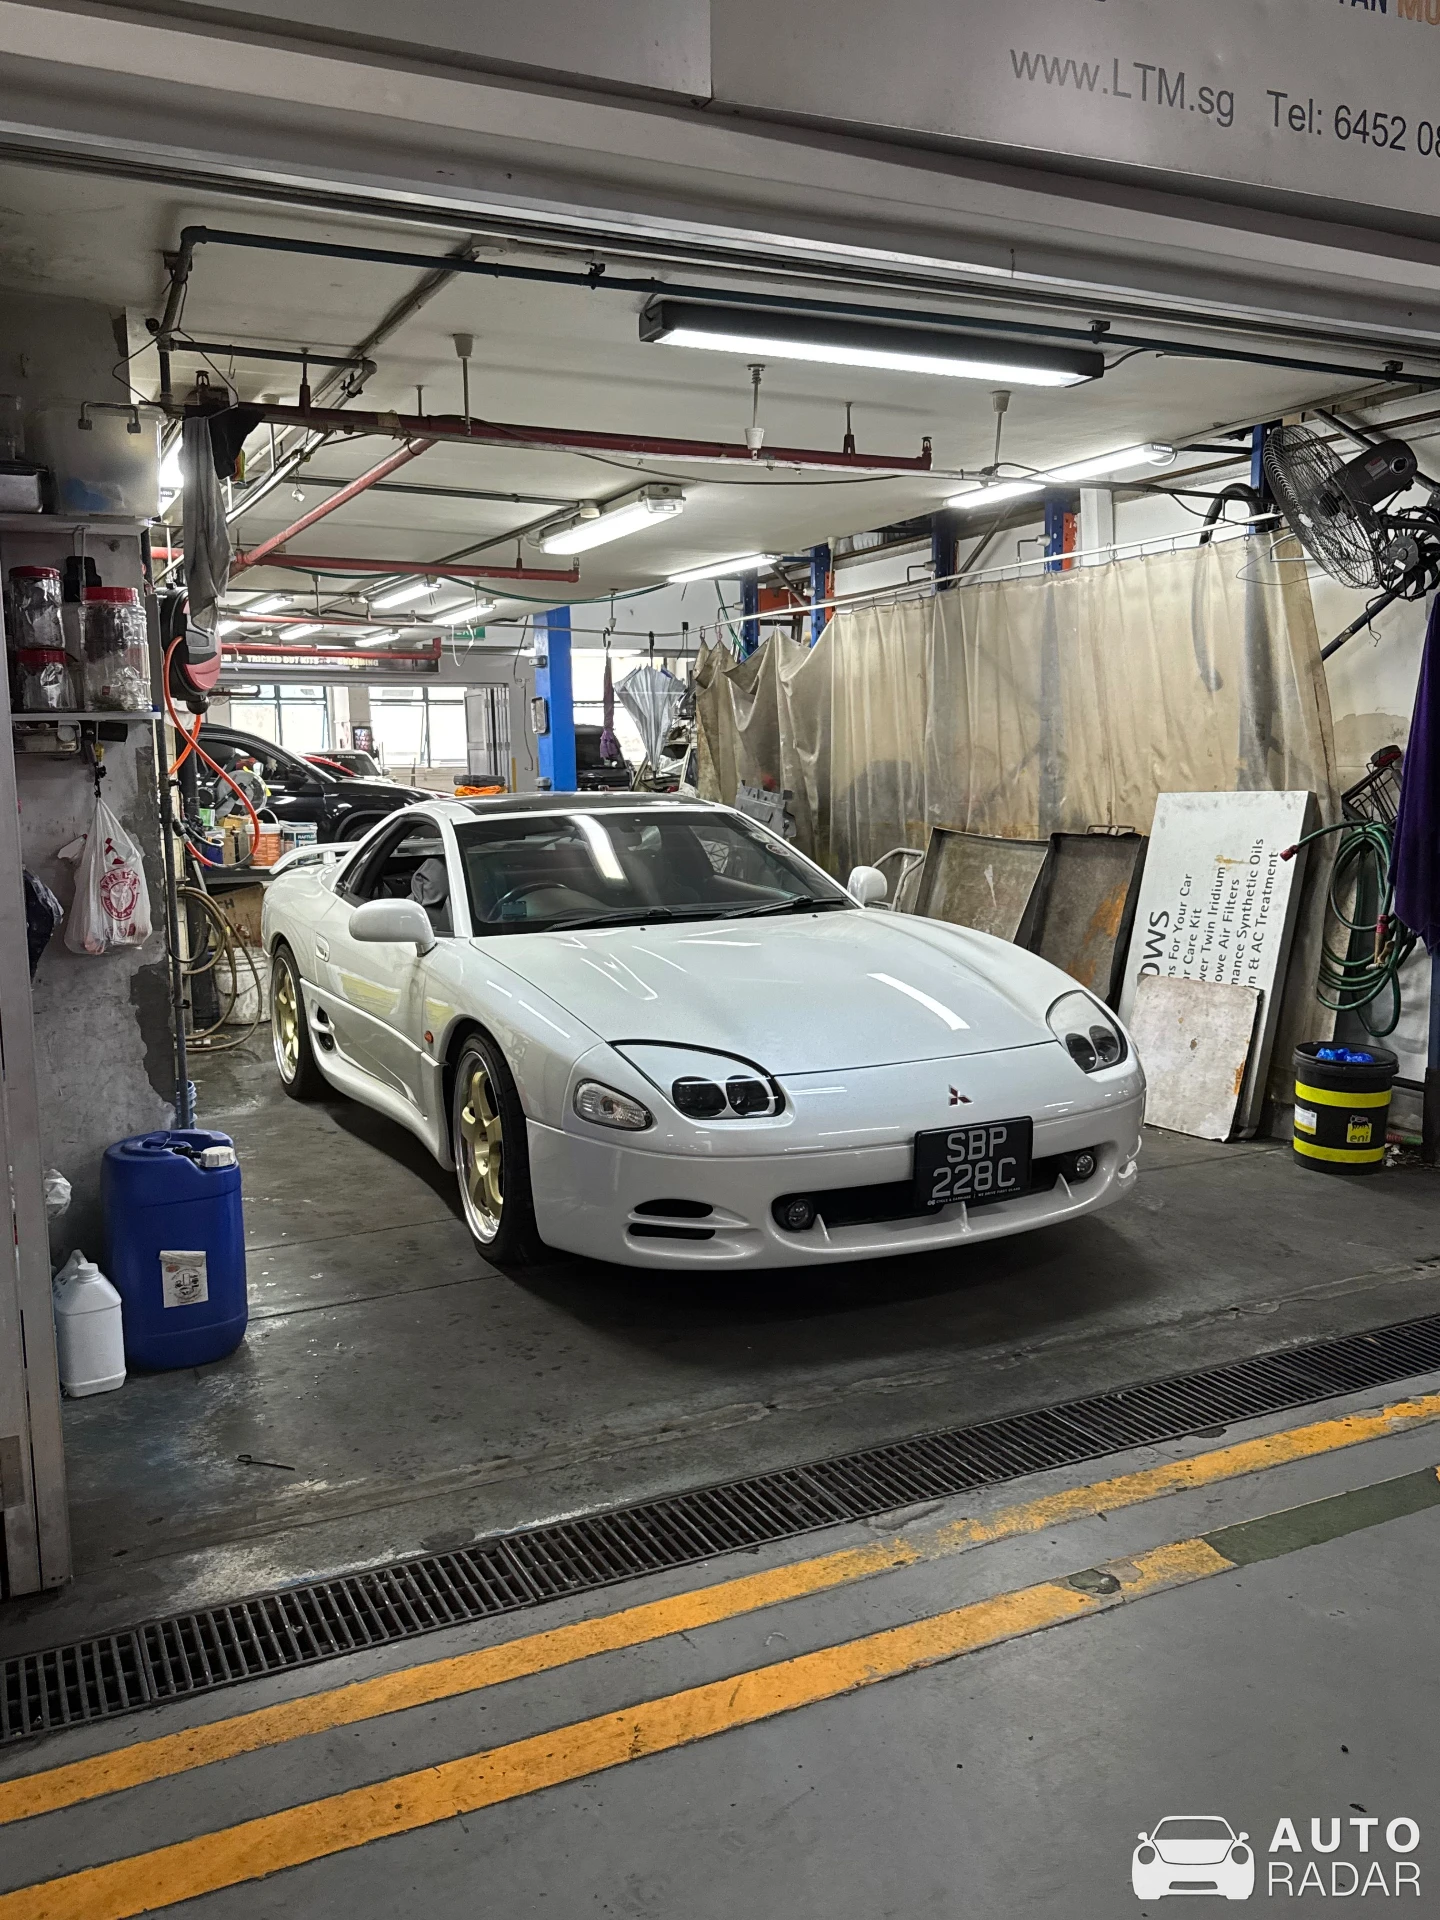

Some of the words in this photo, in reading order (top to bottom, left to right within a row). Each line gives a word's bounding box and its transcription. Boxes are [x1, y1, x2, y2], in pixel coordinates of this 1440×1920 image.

[1009, 48, 1235, 128] www.LTM.sg
[1266, 90, 1323, 136] Tel:
[1334, 105, 1407, 152] 6452
[1180, 873, 1193, 897] Car
[1207, 867, 1226, 915] Iridium
[1223, 879, 1240, 923] Filters
[1237, 870, 1258, 938] Synthetic
[1249, 838, 1264, 865] Oils
[1255, 852, 1279, 927] Treatment
[1172, 901, 1187, 933] Your
[1189, 908, 1202, 928] Kit
[1168, 938, 1181, 960] For
[1182, 934, 1198, 965] Care
[1200, 921, 1215, 953] Twin
[1218, 927, 1231, 949] Air
[1251, 932, 1265, 953] AC
[946, 1126, 1007, 1163] SBP
[1349, 1131, 1369, 1143] eni
[932, 1157, 1017, 1198] 228C
